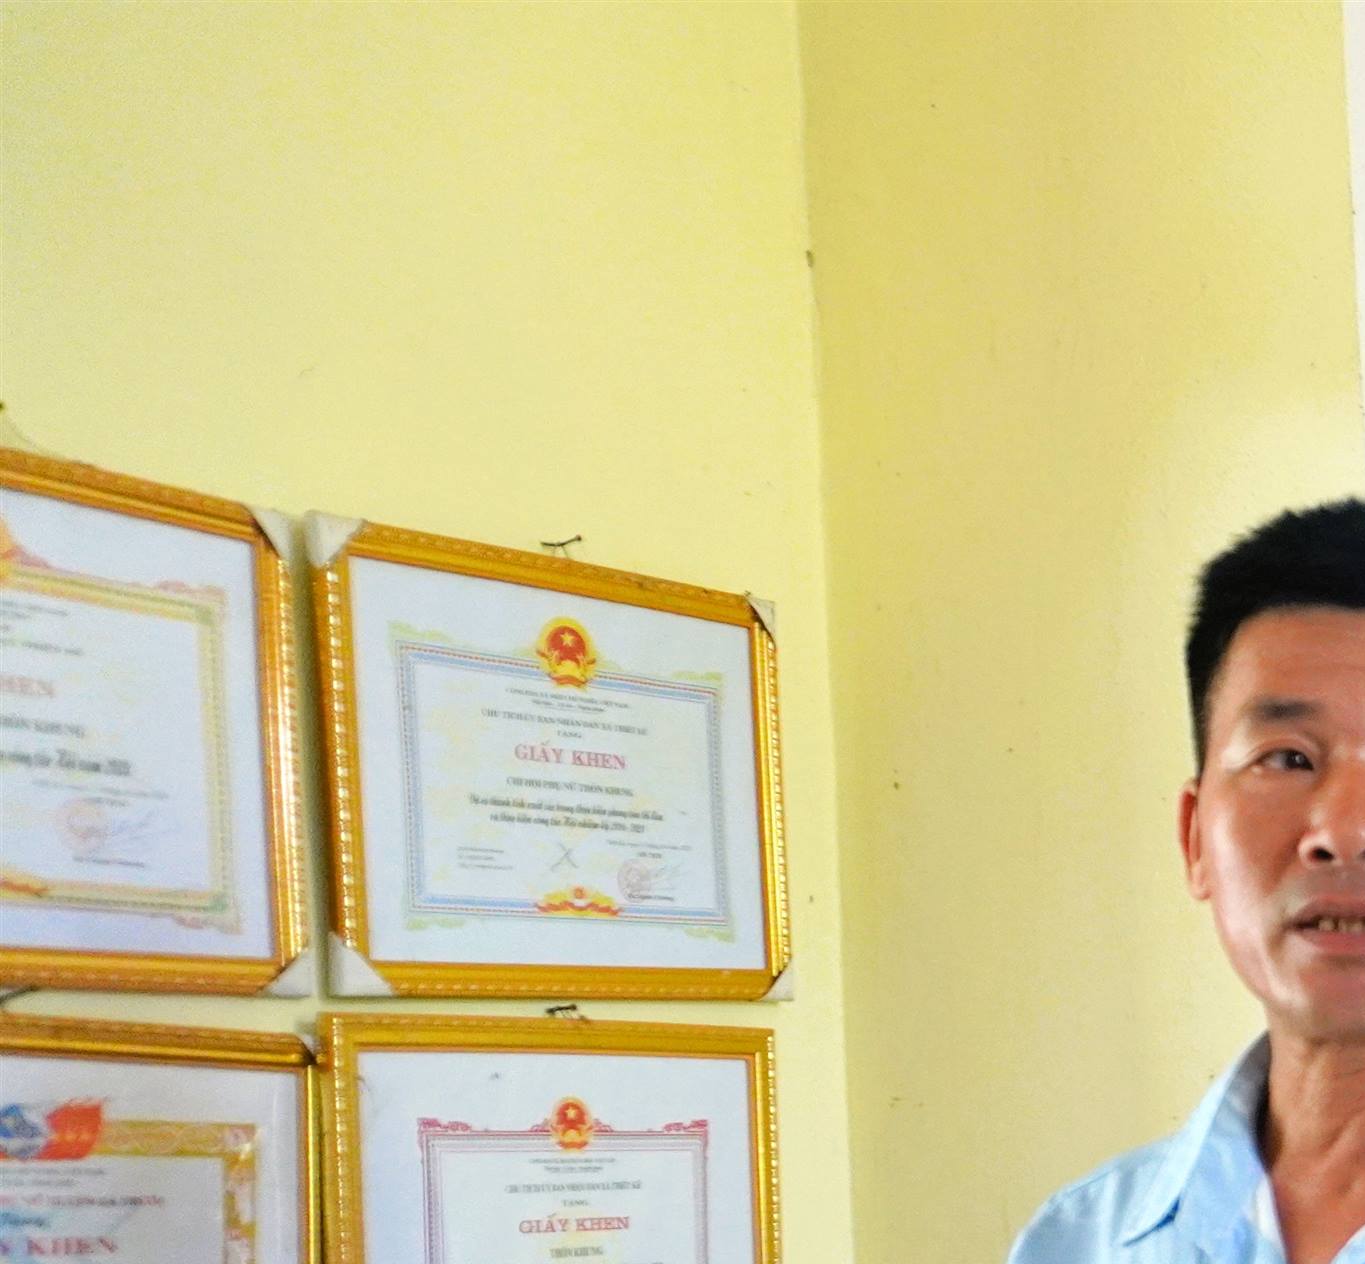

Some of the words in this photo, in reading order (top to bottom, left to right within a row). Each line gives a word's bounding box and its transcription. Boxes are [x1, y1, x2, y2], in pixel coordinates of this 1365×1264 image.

[514, 739, 564, 764] GIẤY
[571, 750, 627, 770] KHEN
[519, 1213, 570, 1234] GIẤY
[575, 1216, 631, 1232] KHEN
